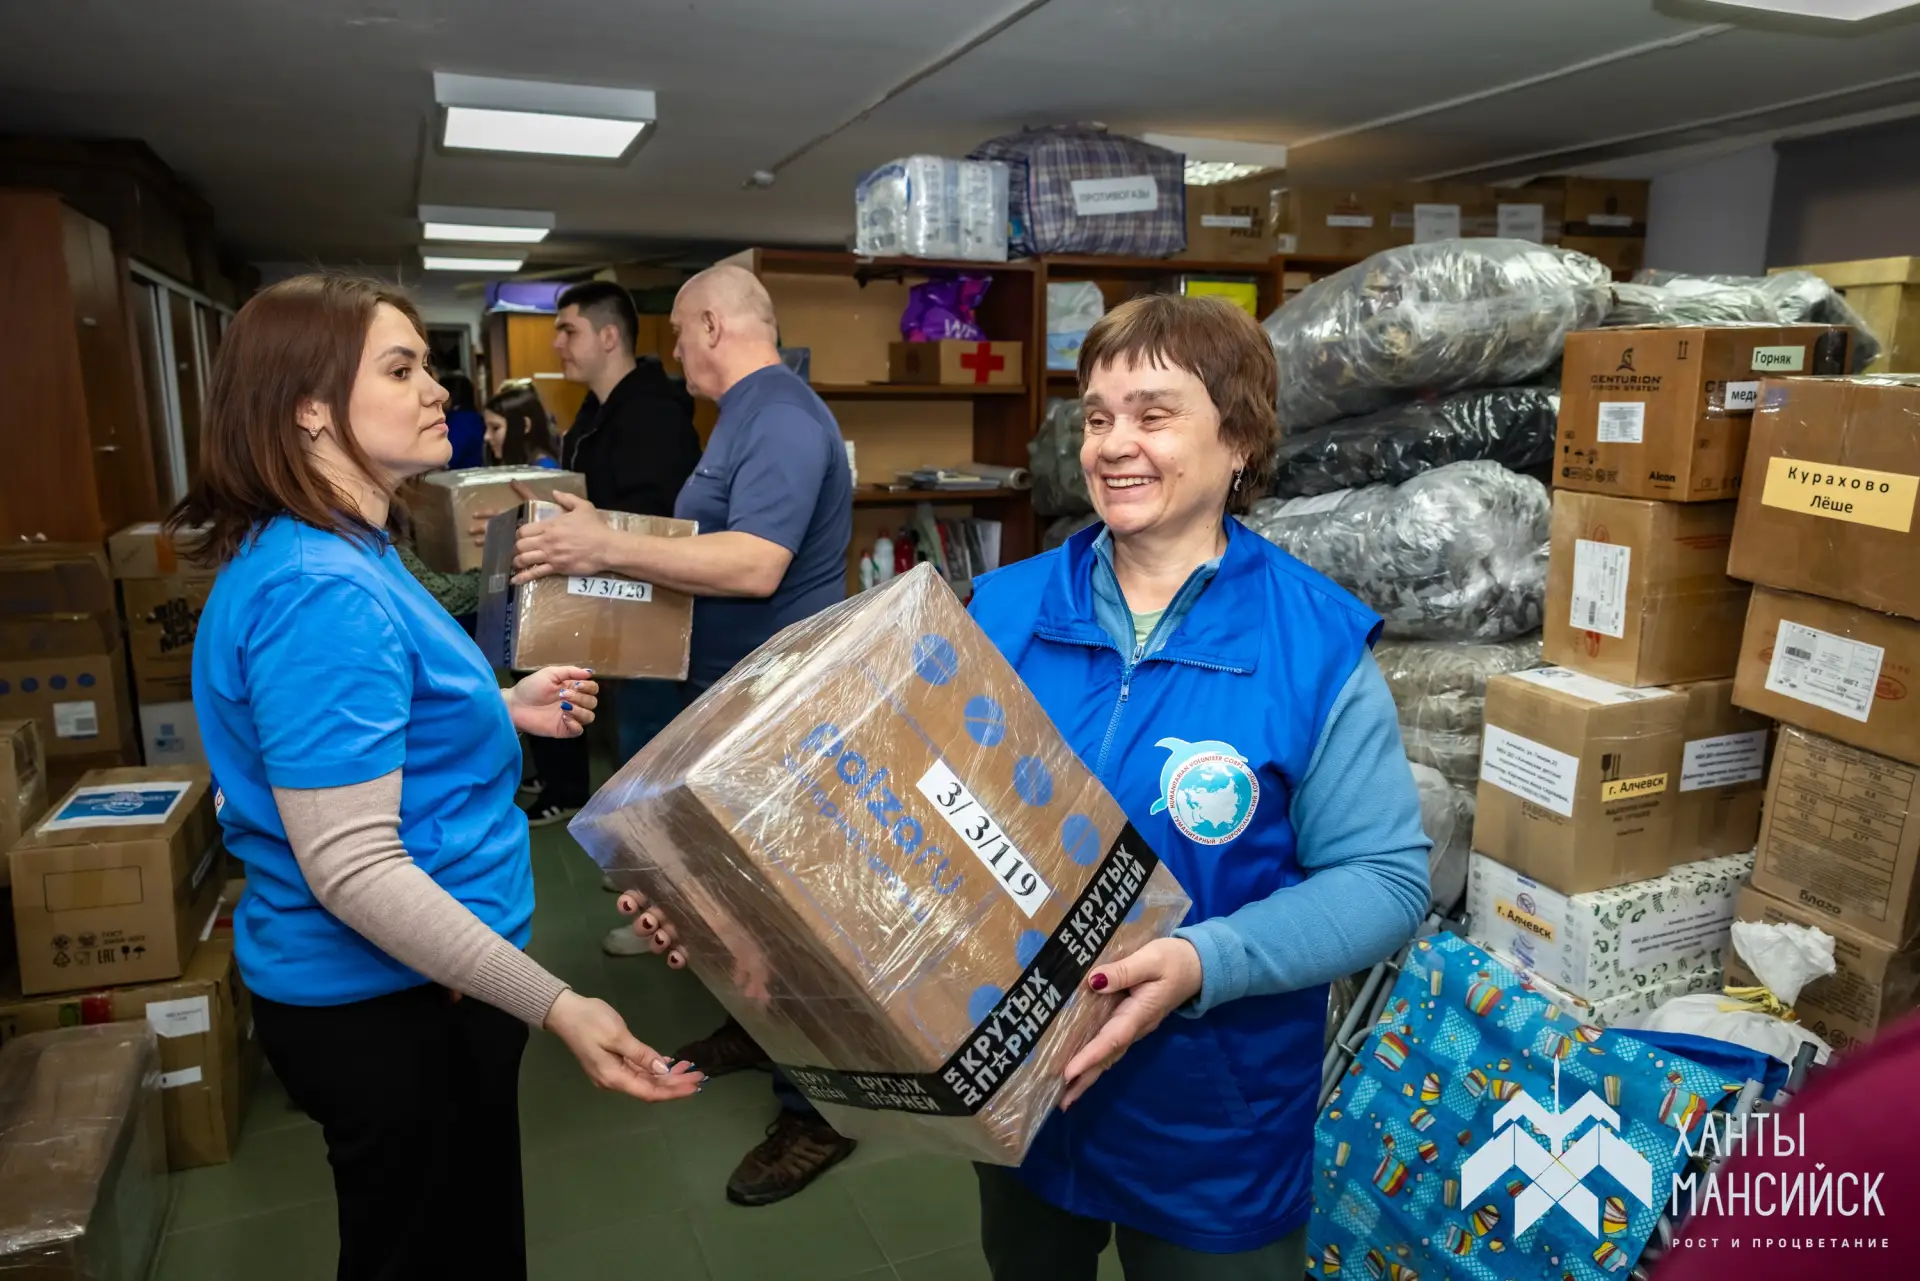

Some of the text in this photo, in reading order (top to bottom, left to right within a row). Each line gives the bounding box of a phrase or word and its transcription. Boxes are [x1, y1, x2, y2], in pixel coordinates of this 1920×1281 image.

[1755, 350, 1792, 366] Горняк
[1591, 374, 1661, 384] CENTURION
[1624, 384, 1660, 392] SYSTEM
[1649, 470, 1676, 482] Alcon
[1788, 466, 1890, 493] Курахово
[1810, 494, 1854, 514] Лёше
[1169, 755, 1245, 809] HUMANITARIAN VOLUNTEER CORPS
[1620, 776, 1665, 793] Алчевск
[936, 781, 1038, 897] 3/ 3/119
[1173, 815, 1216, 844] ГУМАНИТАРНЫЙ
[1070, 843, 1135, 936] КРУТЫХ
[1507, 909, 1551, 940] Алчевск
[1058, 927, 1092, 967] ДЛЯ
[957, 966, 1049, 1075] КРУТЫХ
[852, 1075, 928, 1095] КРУТЫХ
[942, 1066, 983, 1108] ДЛЯ
